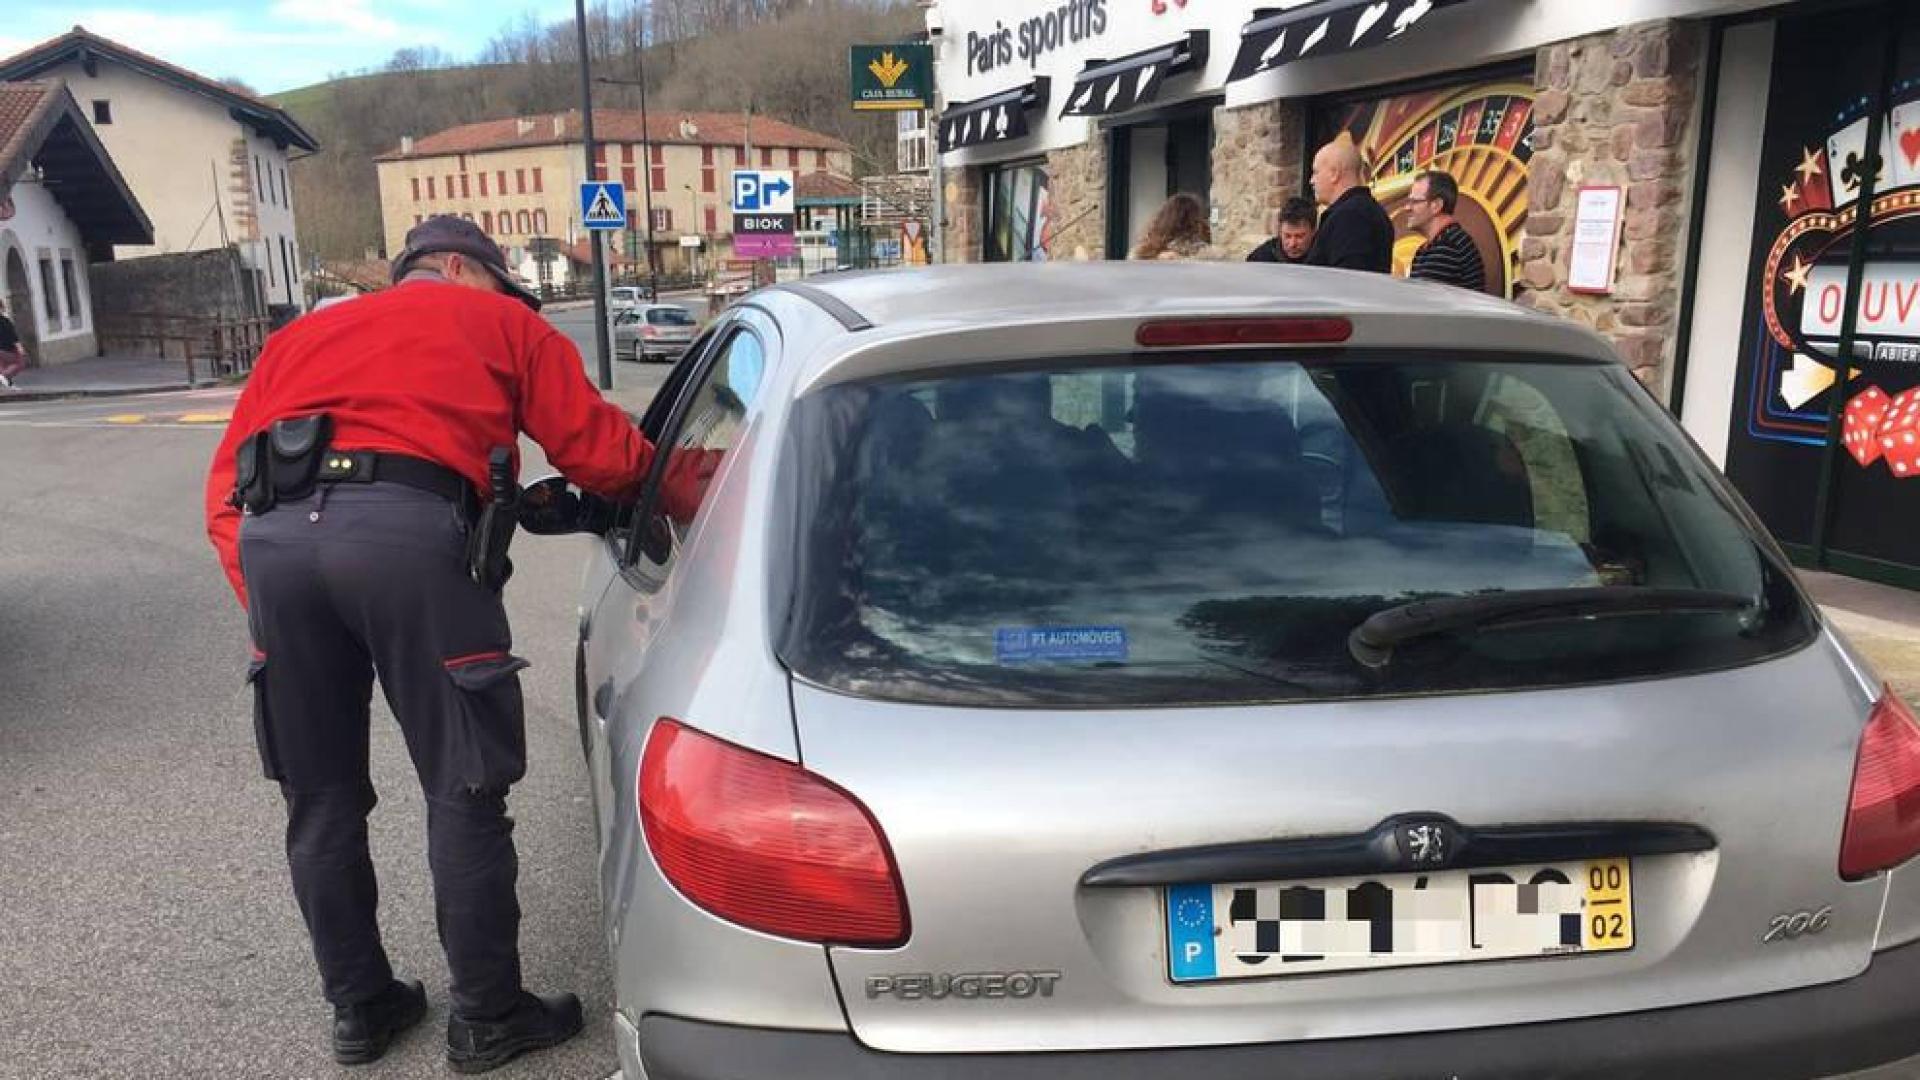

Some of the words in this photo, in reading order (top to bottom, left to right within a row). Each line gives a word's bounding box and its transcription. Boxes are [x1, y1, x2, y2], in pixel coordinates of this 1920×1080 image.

[967, 20, 1012, 77] Paris
[737, 177, 757, 206] P
[744, 218, 782, 230] BIOK
[1590, 866, 1621, 891] 00
[1592, 913, 1624, 939] 02
[1763, 904, 1832, 944] 206
[1184, 941, 1202, 963] P
[866, 972, 1061, 1000] PEUGEOT
